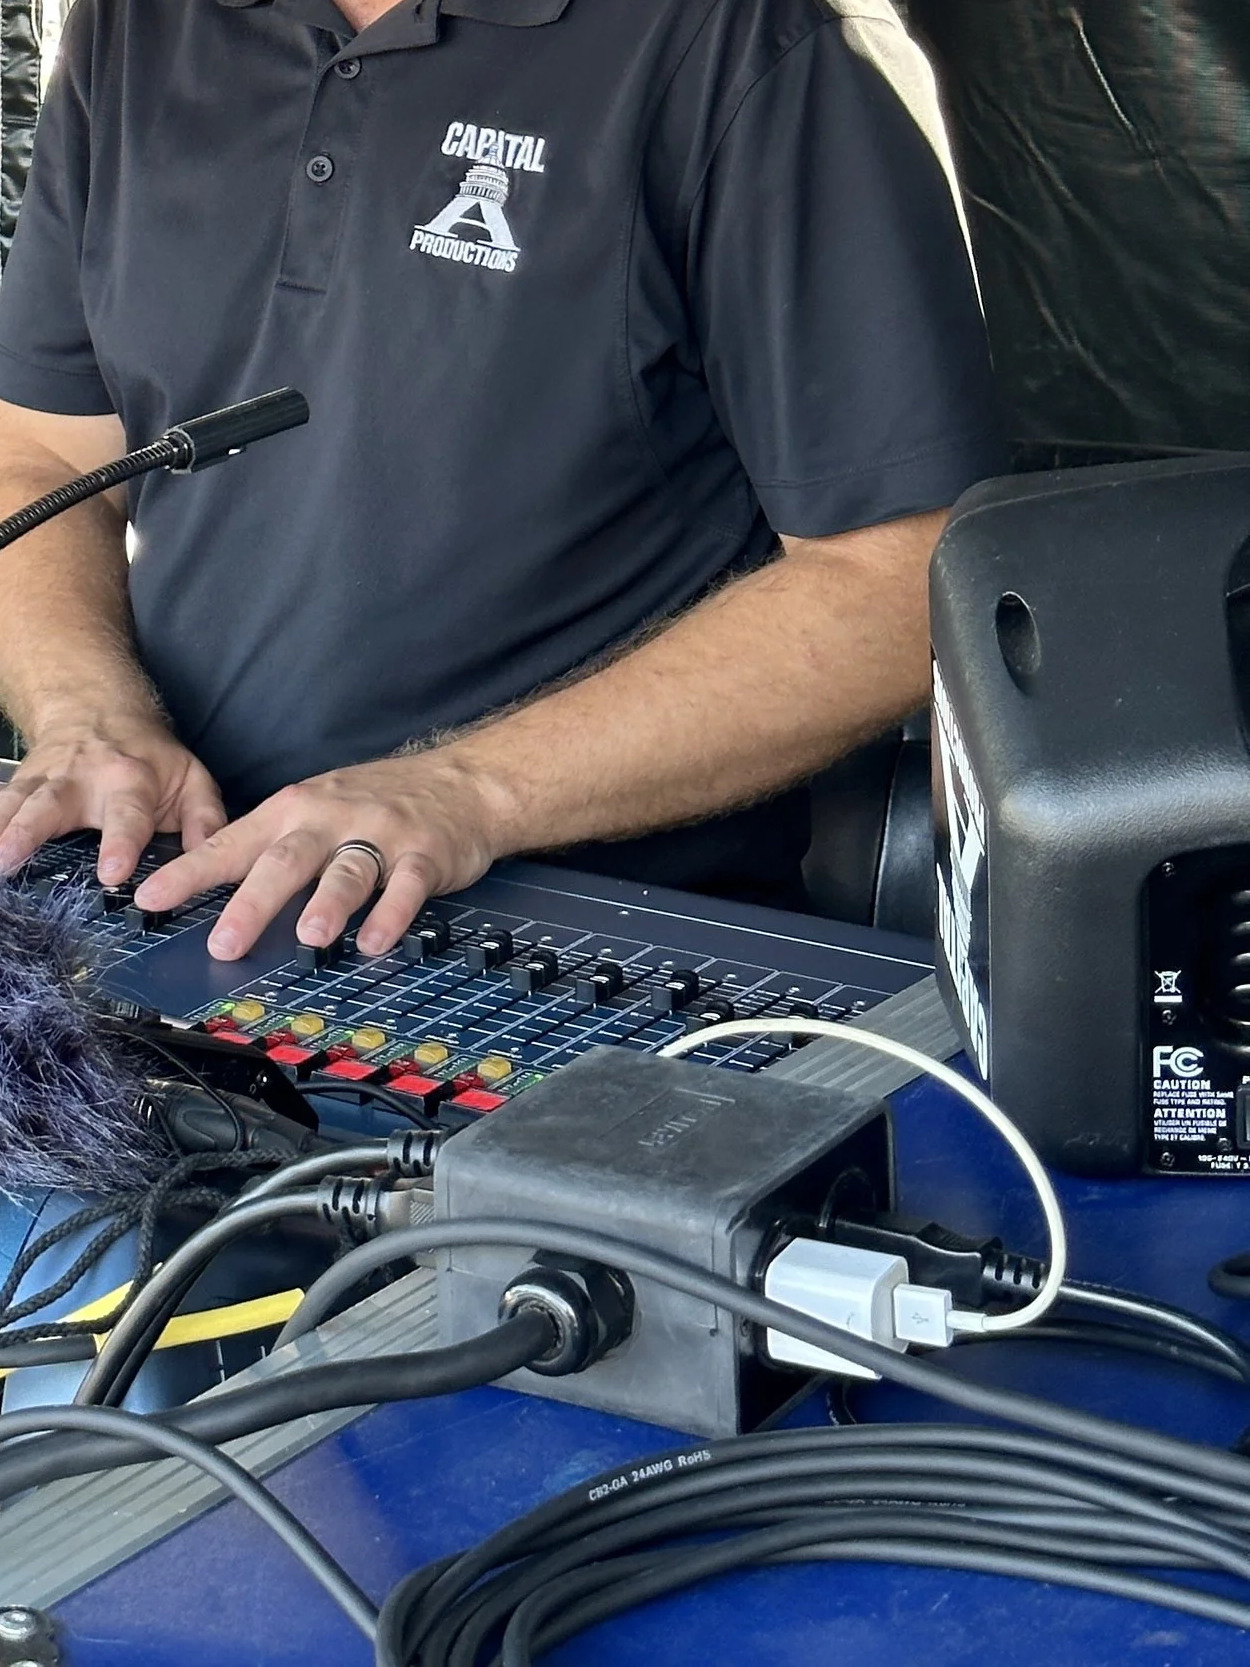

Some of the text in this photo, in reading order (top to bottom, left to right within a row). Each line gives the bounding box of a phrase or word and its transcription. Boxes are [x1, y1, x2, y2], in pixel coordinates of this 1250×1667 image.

[441, 121, 546, 173] CAPITAL
[409, 230, 518, 273] PRODUCTIONS
[1153, 1079, 1211, 1090] CAUTION
[1153, 1108, 1226, 1119] ATTENTION
[631, 1459, 674, 1482] 24AWG
[678, 1450, 711, 1467] RoHS
